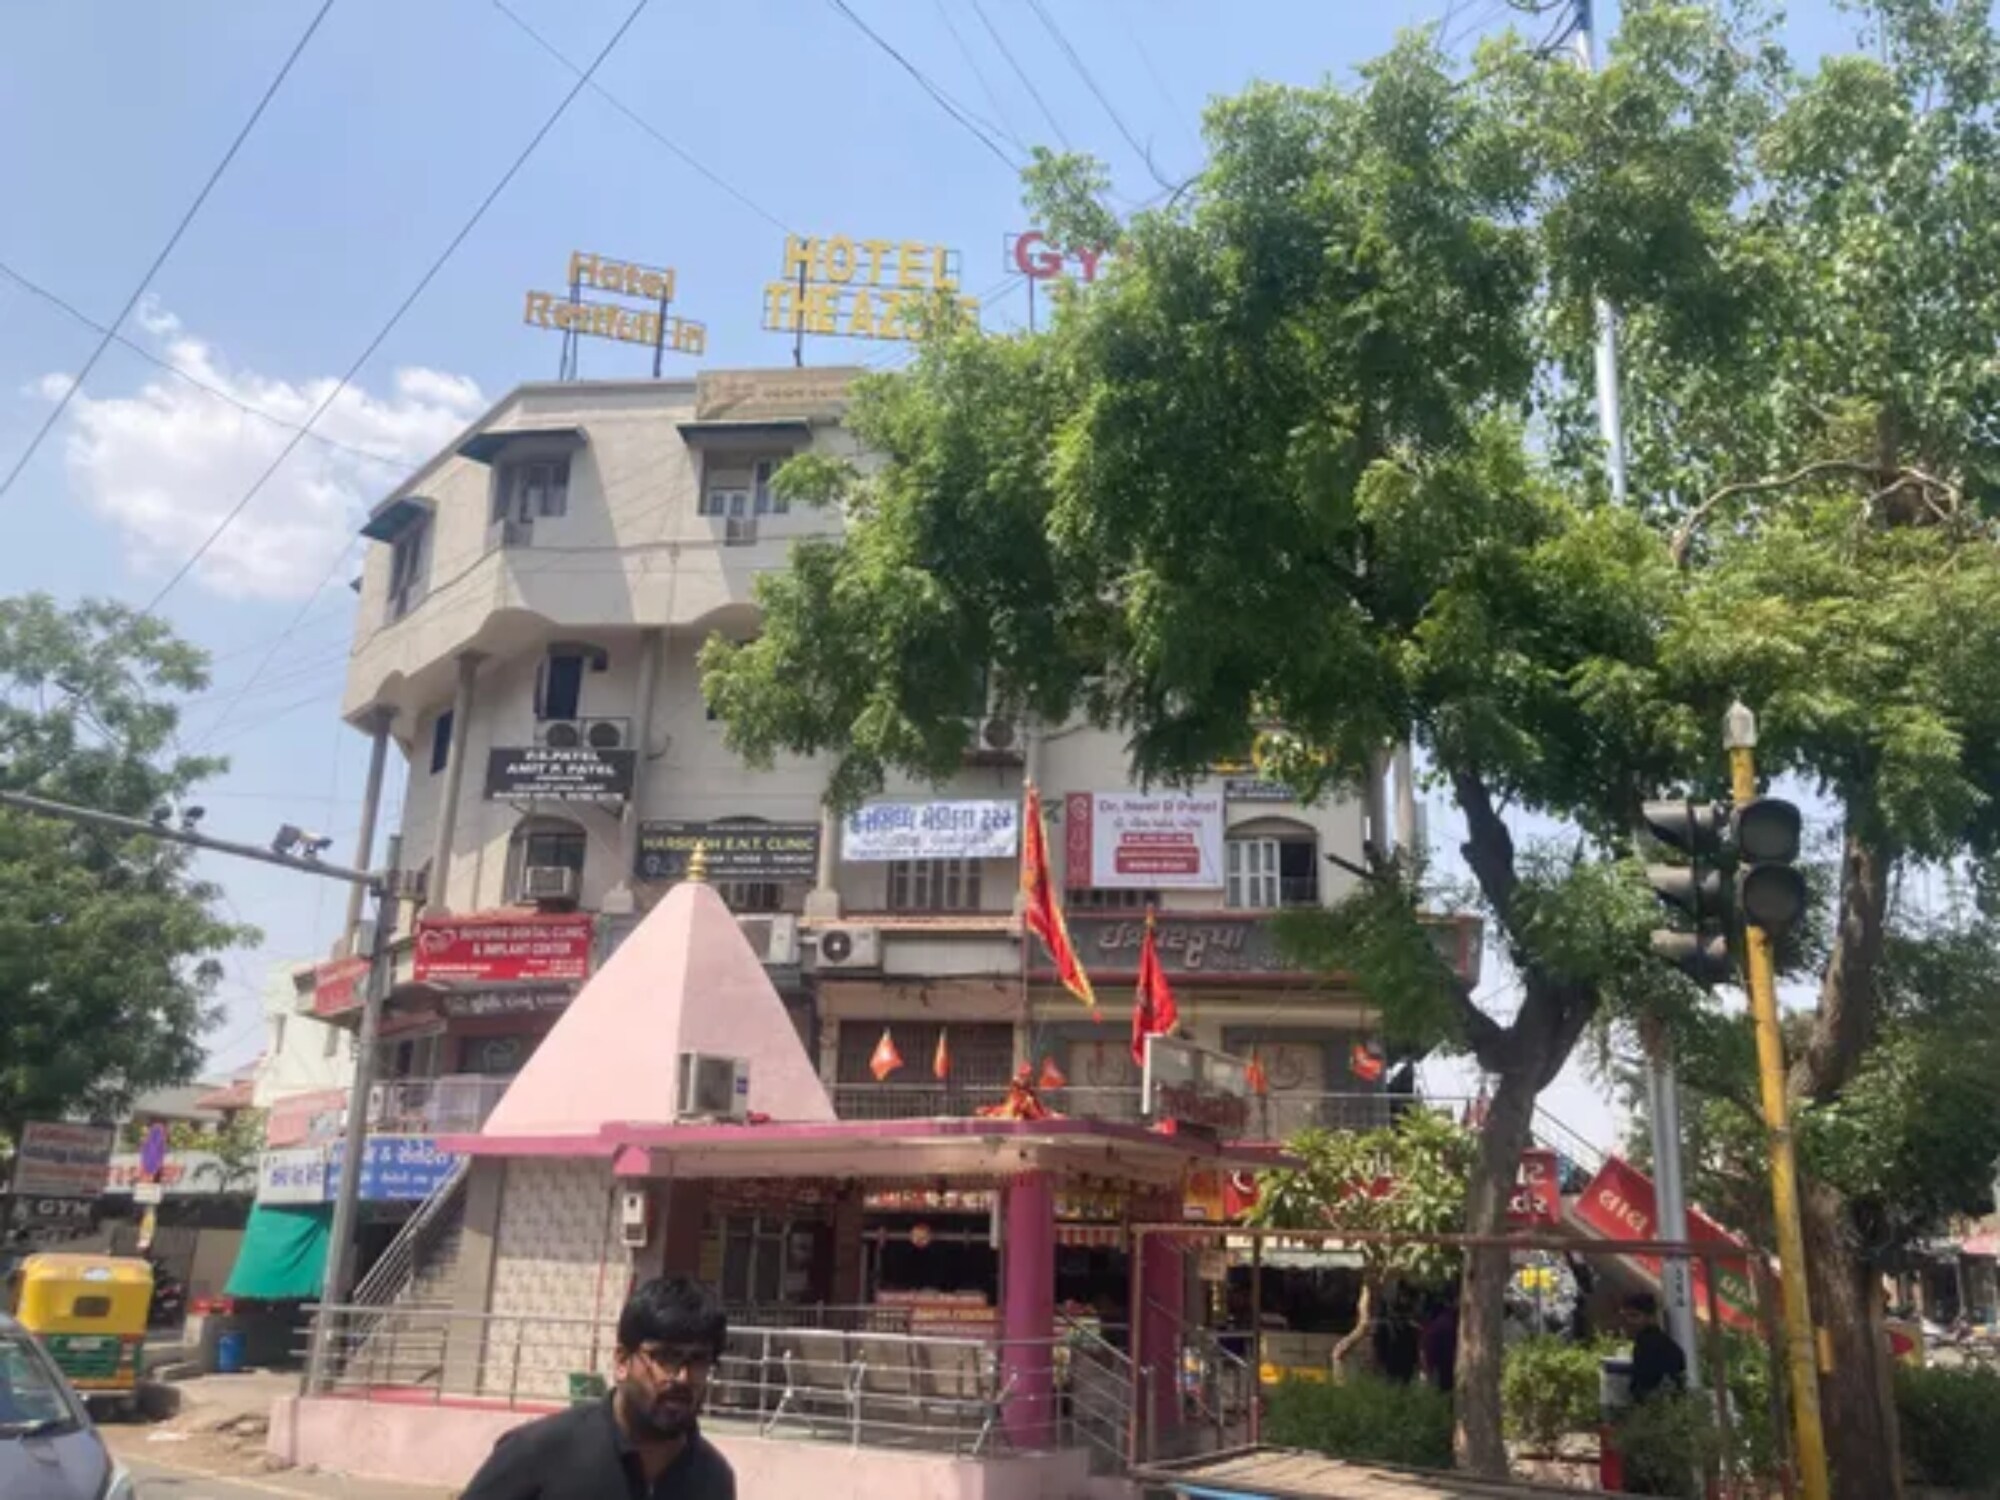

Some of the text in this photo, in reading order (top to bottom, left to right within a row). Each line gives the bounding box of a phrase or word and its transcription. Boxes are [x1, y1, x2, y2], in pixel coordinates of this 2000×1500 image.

[570, 251, 674, 303] Hotel
[785, 234, 956, 287] HOTEL
[766, 282, 837, 332] THE
[506, 763, 547, 774] AMIT
[566, 763, 615, 776] PATEL
[766, 838, 815, 850] CLINIC
